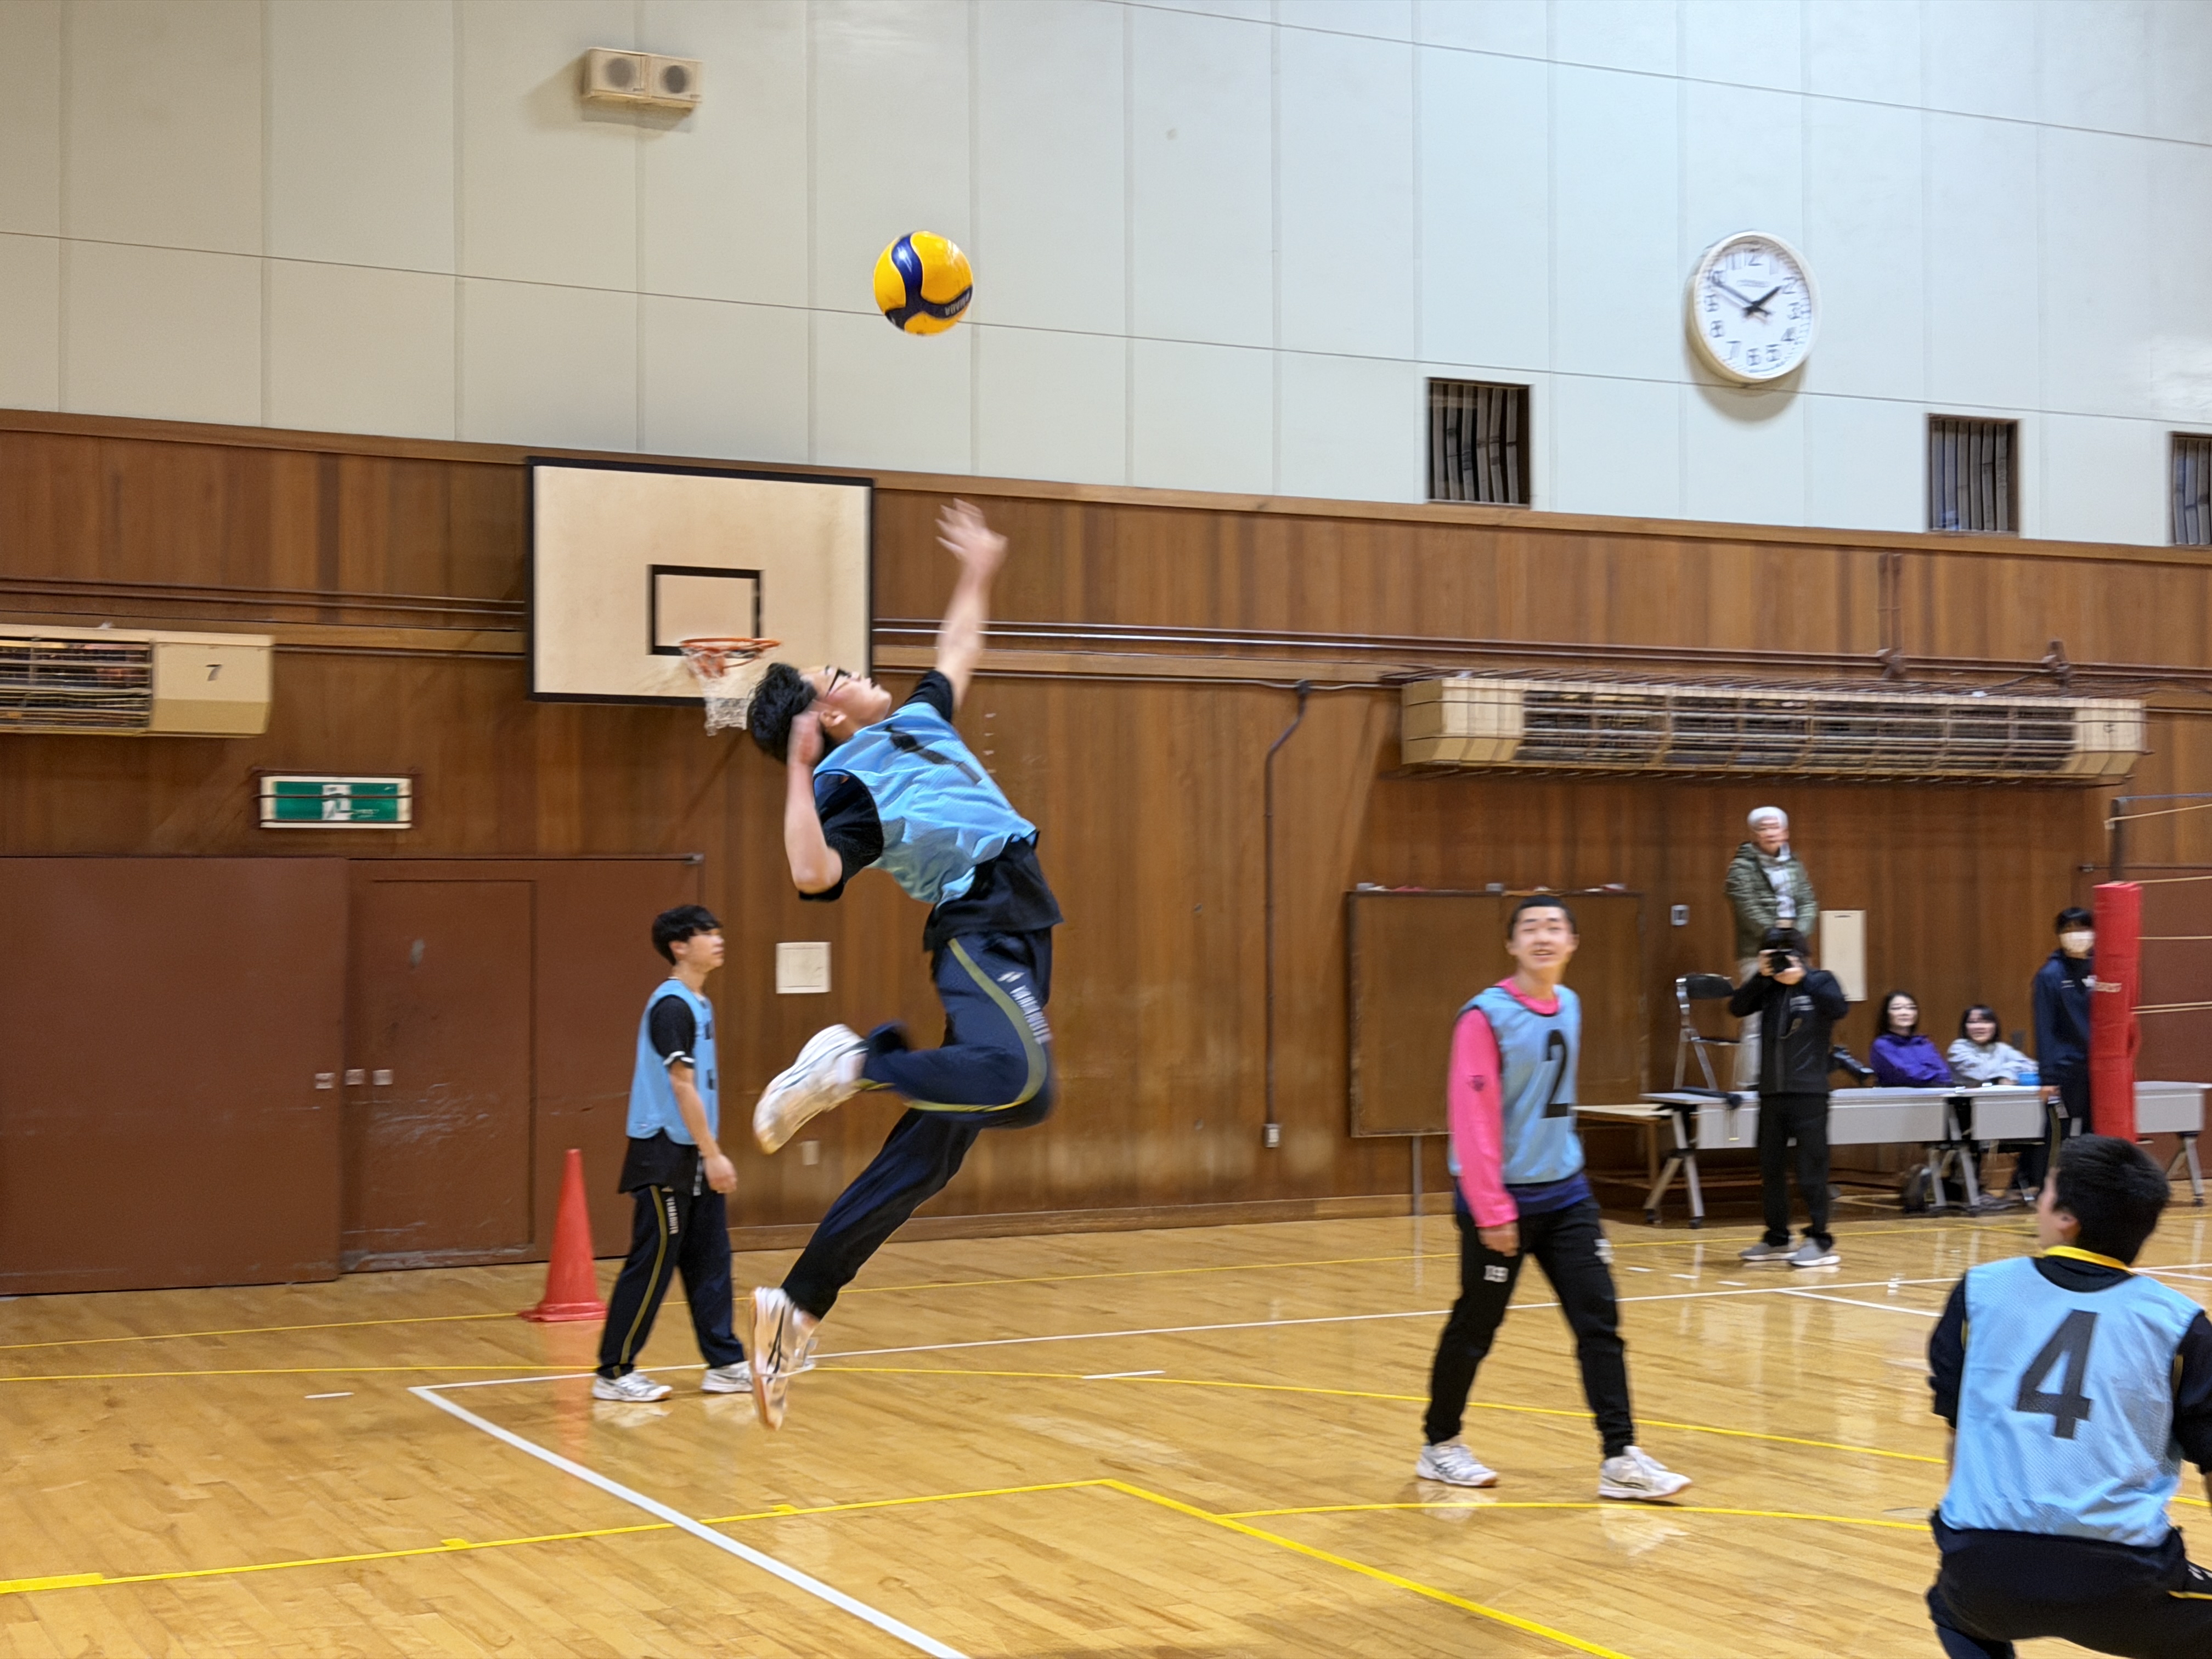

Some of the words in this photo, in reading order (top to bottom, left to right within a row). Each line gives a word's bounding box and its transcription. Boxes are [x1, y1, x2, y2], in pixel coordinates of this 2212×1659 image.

[205, 664, 223, 681] 7
[1540, 1028, 1576, 1119] 2
[2013, 1308, 2098, 1440] 4
